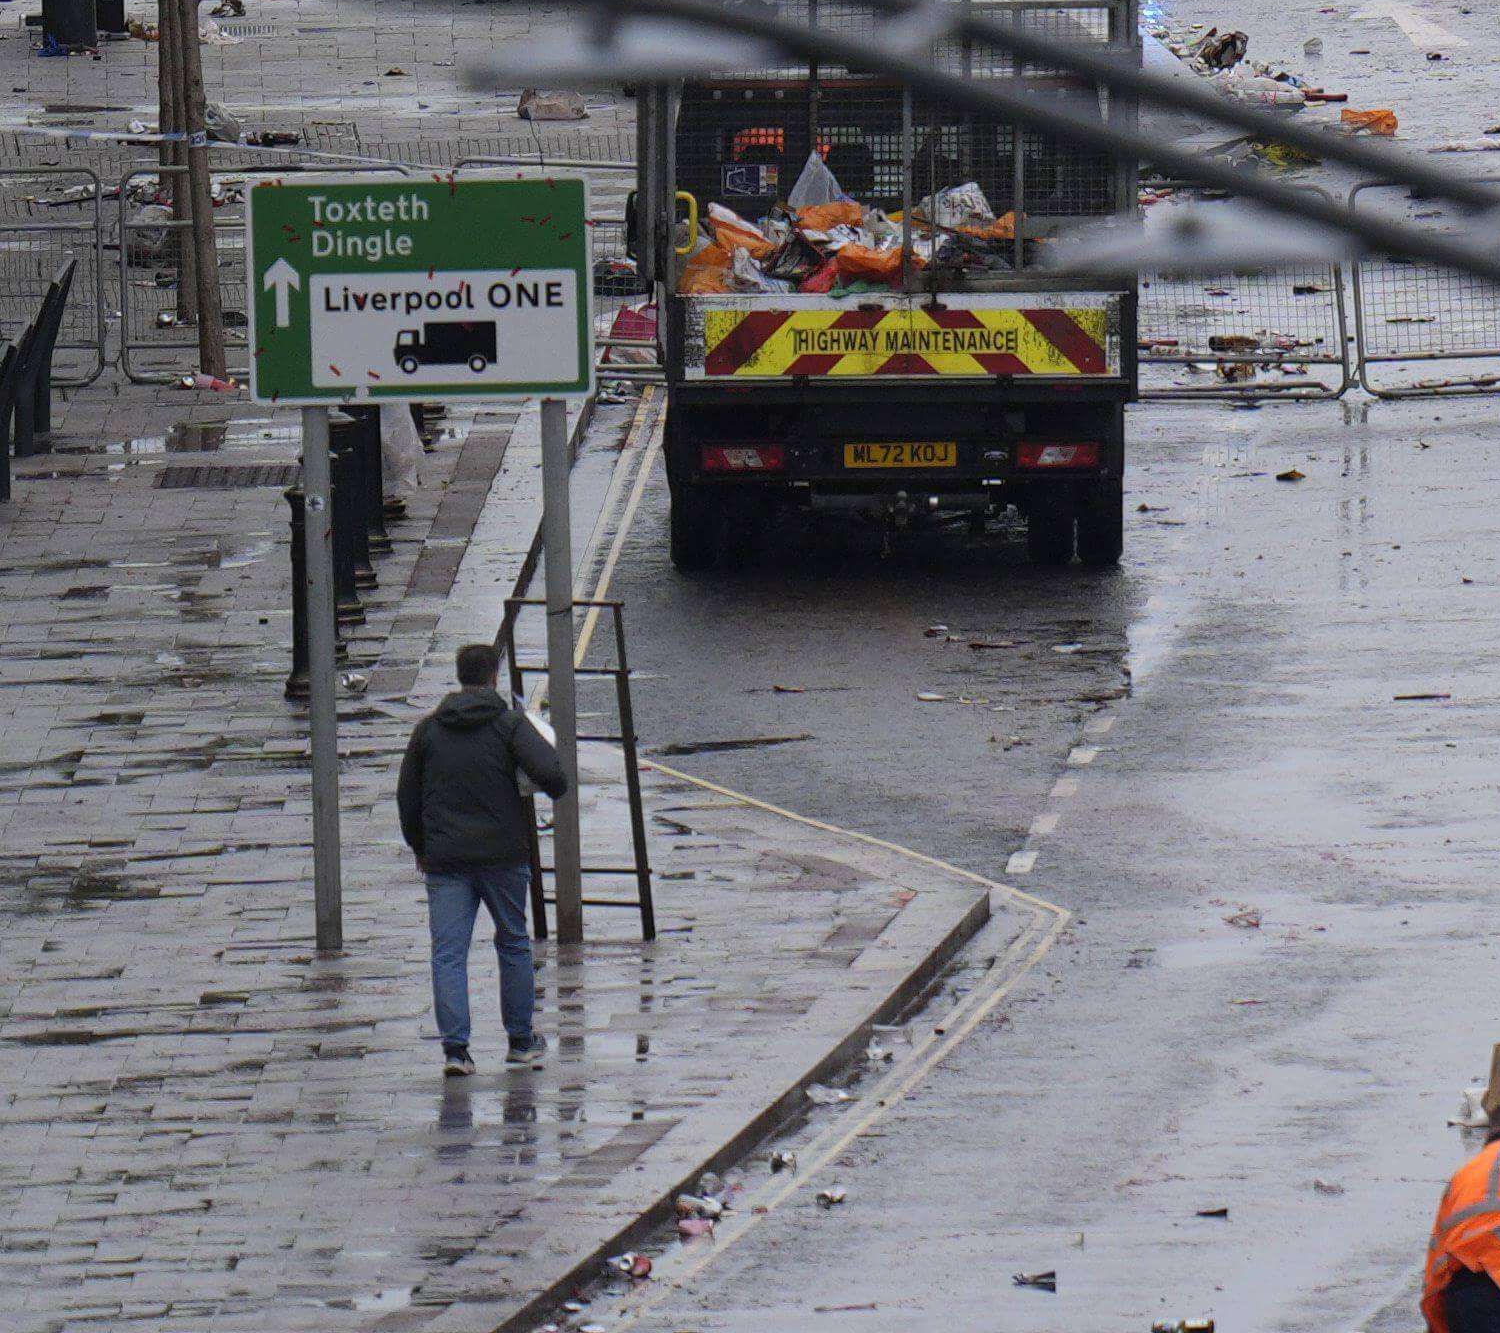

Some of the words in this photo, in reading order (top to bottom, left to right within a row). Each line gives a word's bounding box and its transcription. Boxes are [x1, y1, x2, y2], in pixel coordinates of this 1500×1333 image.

[309, 194, 429, 224] Toxteth
[311, 230, 414, 263] Dingle
[324, 282, 476, 315] Liverpool
[488, 281, 563, 309] ONE
[799, 329, 880, 353] HIGHWAY
[886, 328, 1017, 353] MAINTENANCE
[853, 445, 905, 464] ML72
[910, 444, 949, 463] KOJ
